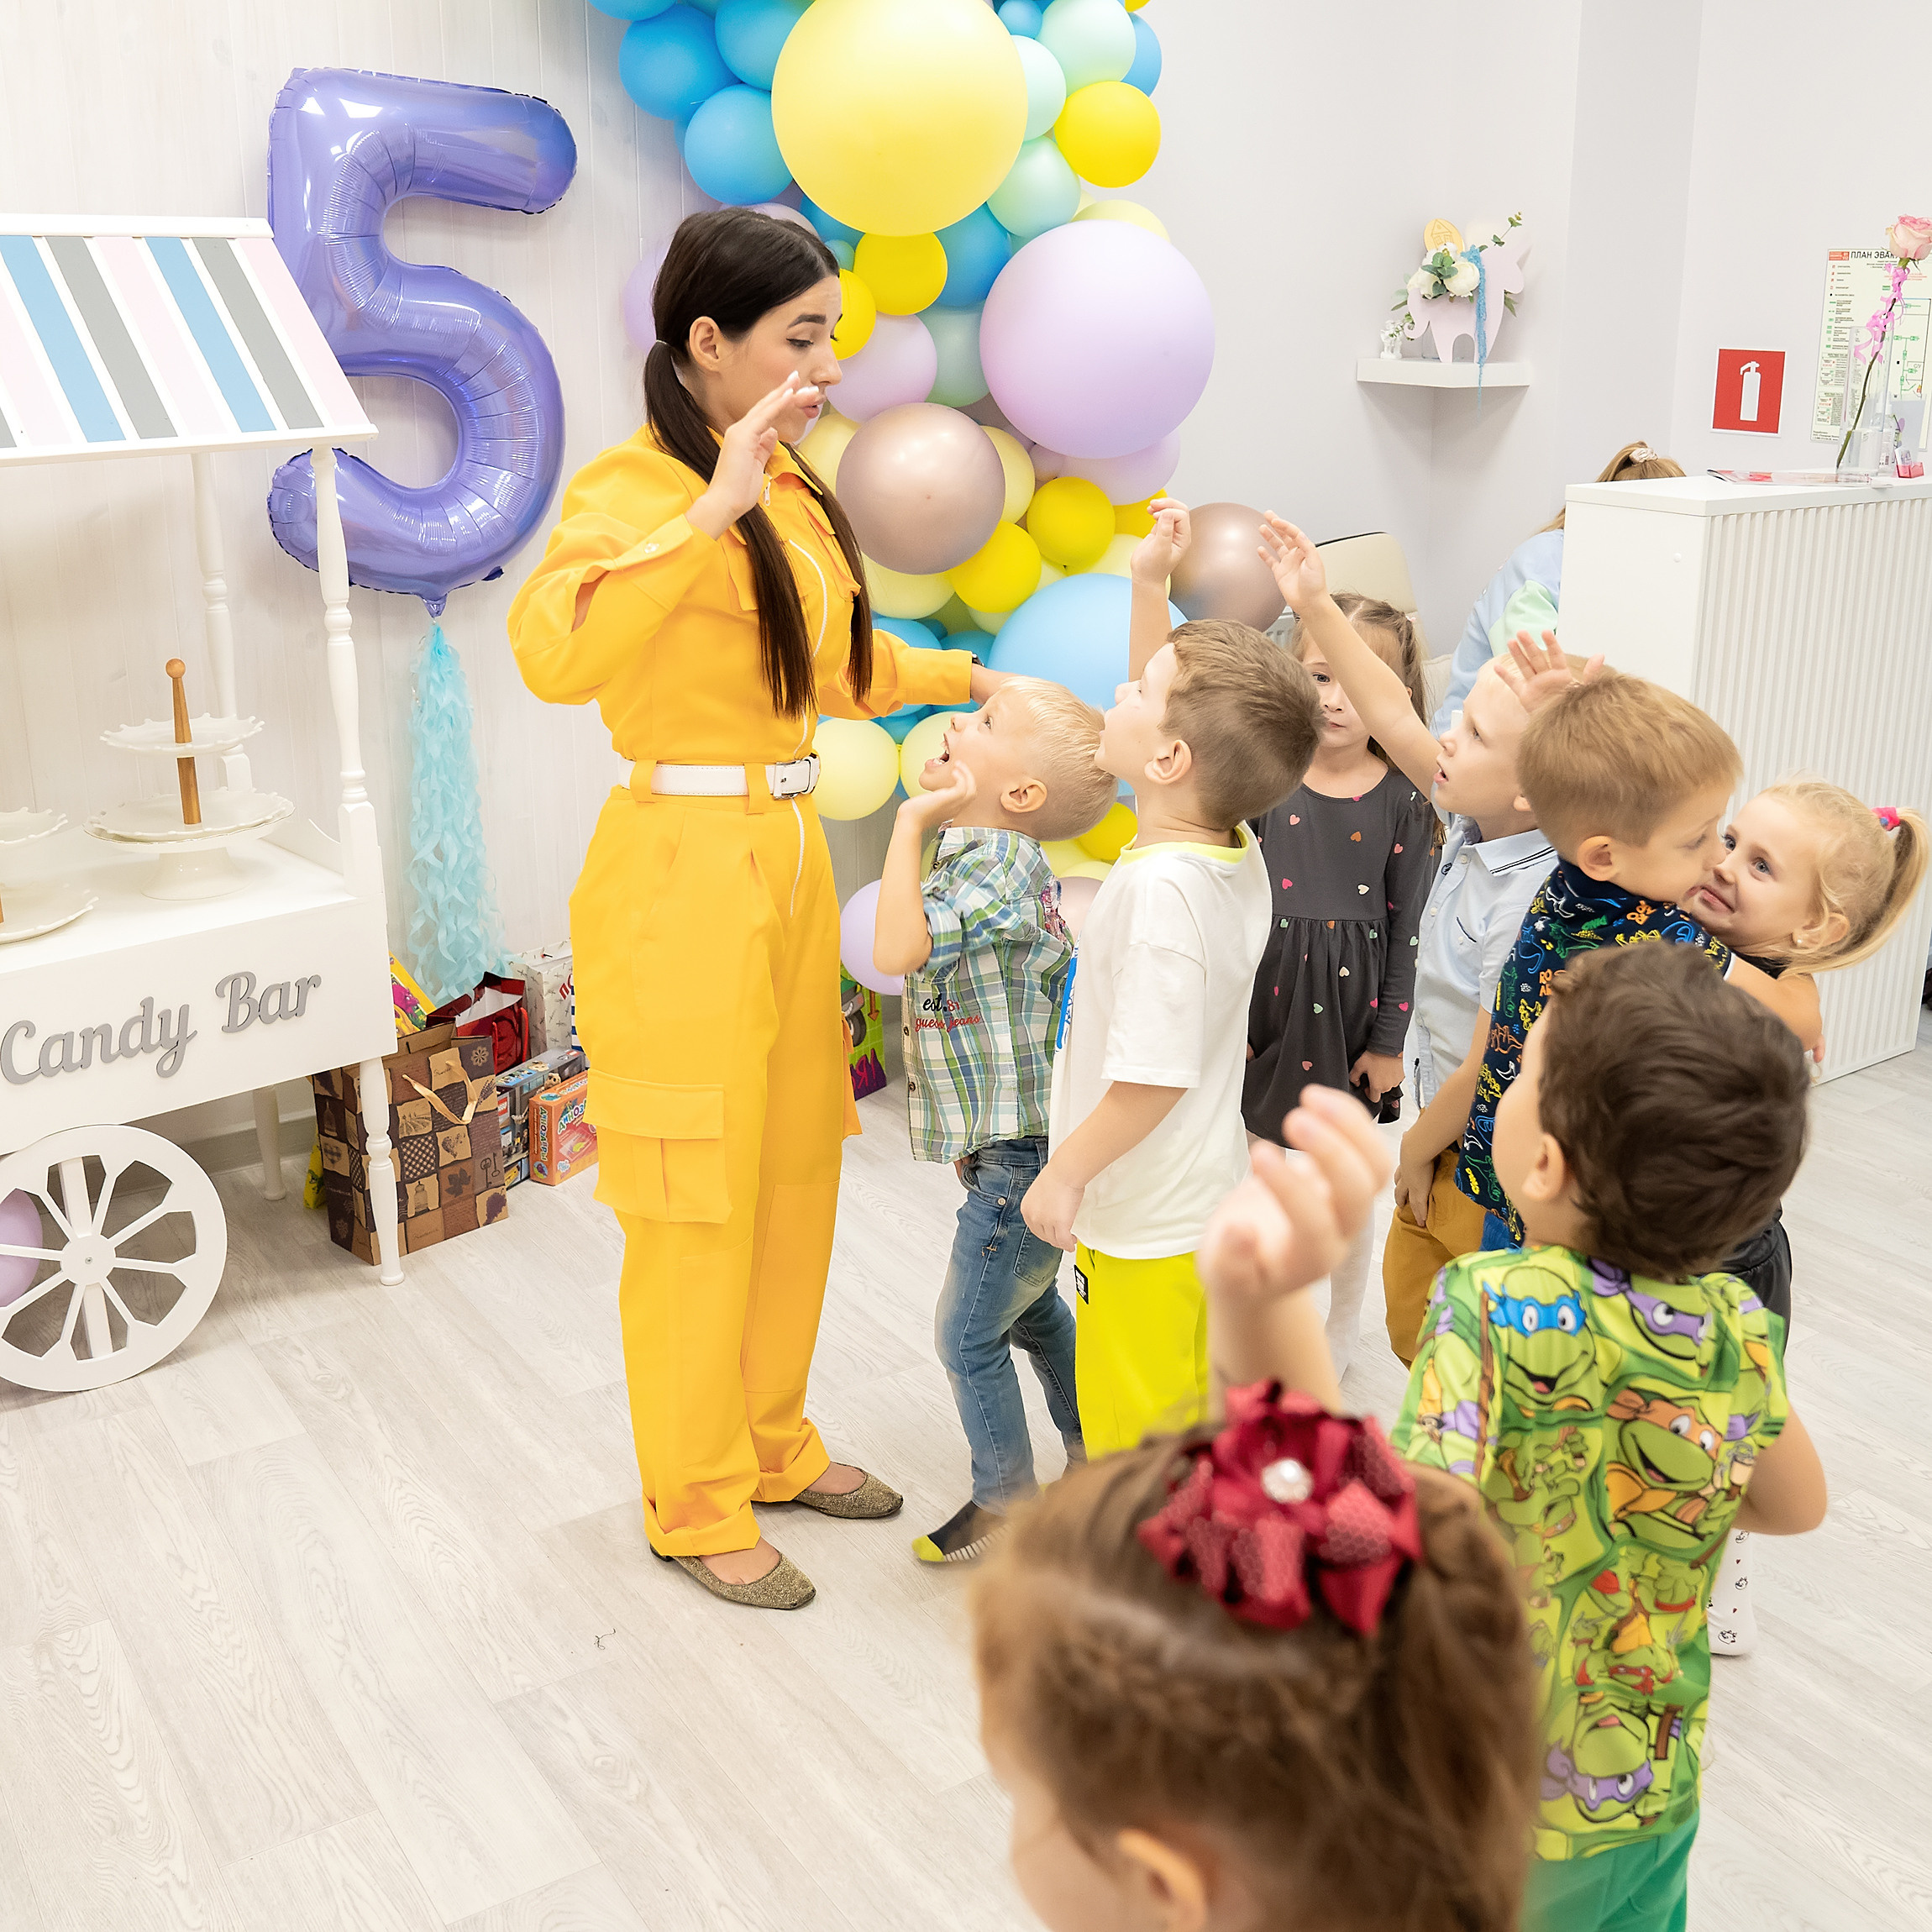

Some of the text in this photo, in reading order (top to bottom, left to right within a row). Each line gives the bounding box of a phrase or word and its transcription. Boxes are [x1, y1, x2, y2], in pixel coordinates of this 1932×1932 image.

[0, 971, 322, 1084] Candy Bar
[915, 1015, 981, 1032] guess jeans
